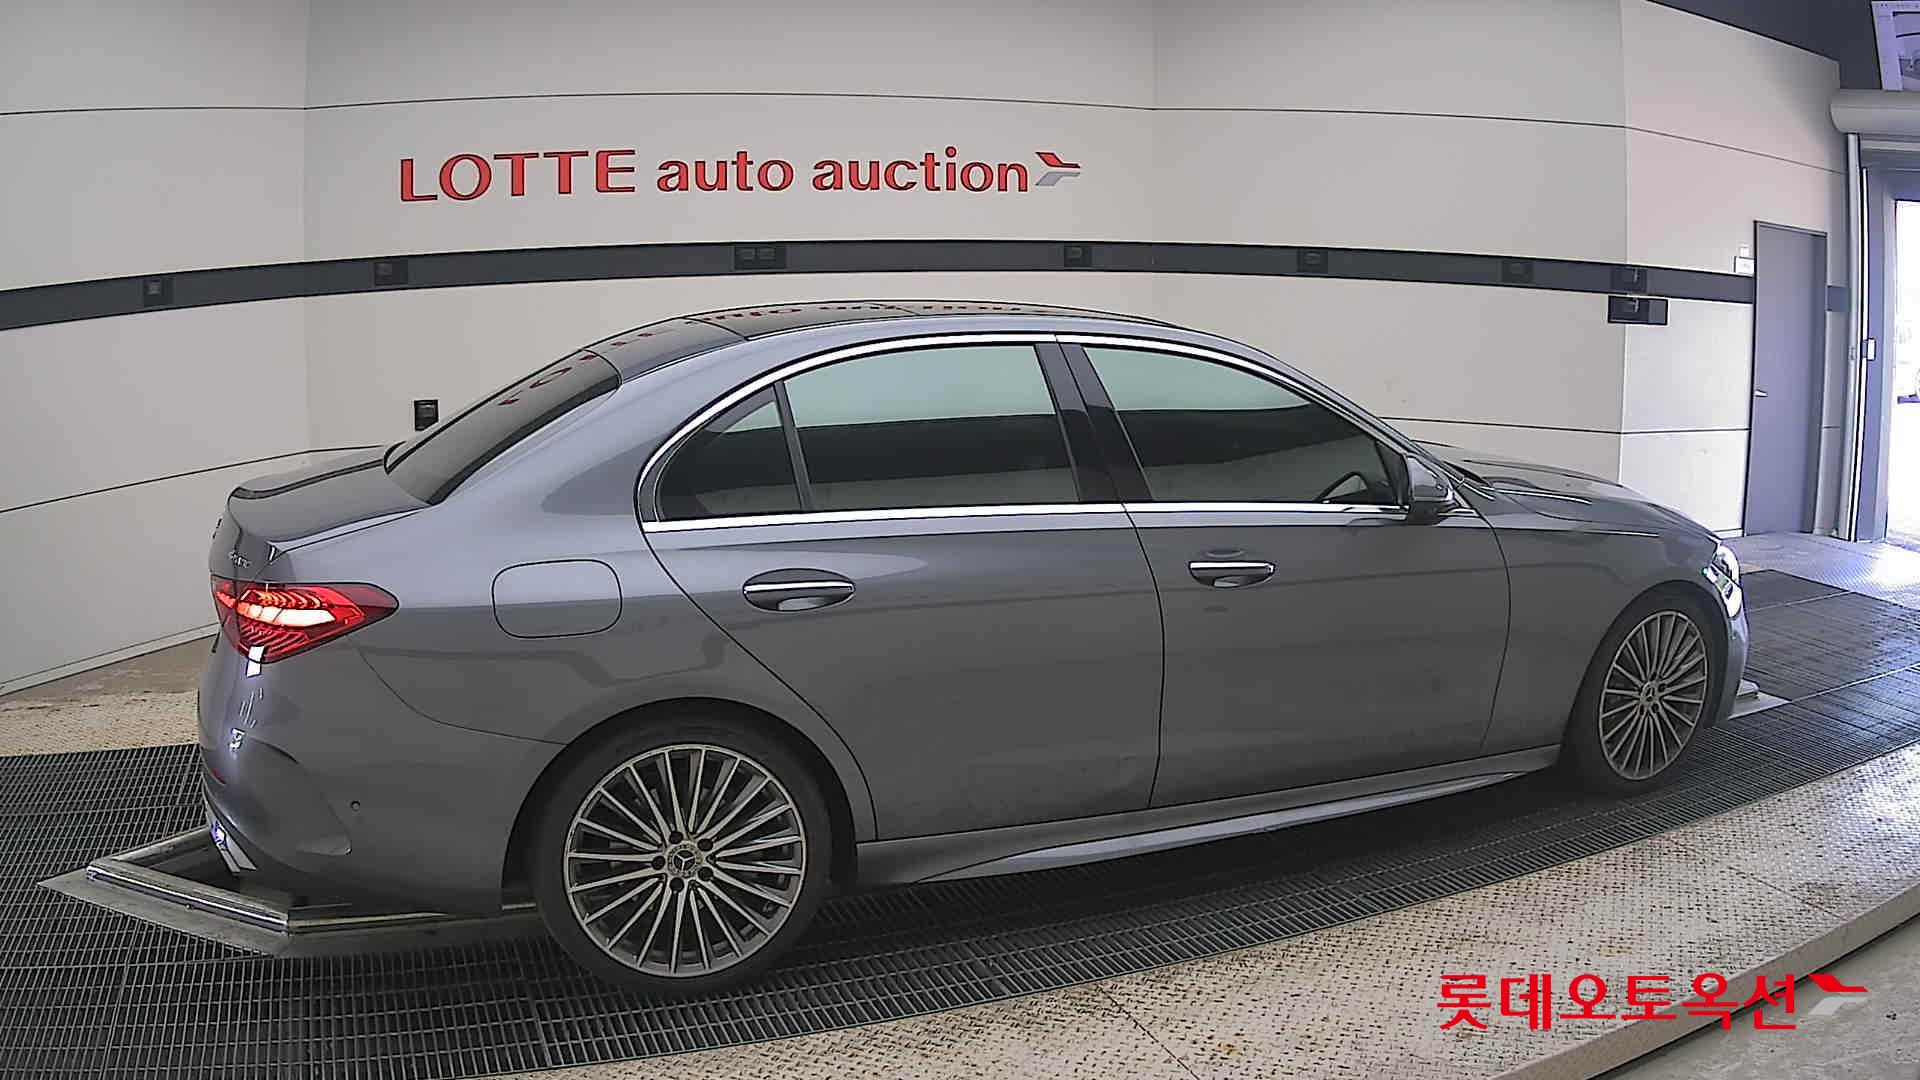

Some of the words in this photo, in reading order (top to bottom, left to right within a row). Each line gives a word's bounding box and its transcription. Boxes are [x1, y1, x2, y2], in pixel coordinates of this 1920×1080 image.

[400, 149, 637, 202] LOTTE
[656, 150, 795, 193] auto
[812, 146, 1030, 194] auction
